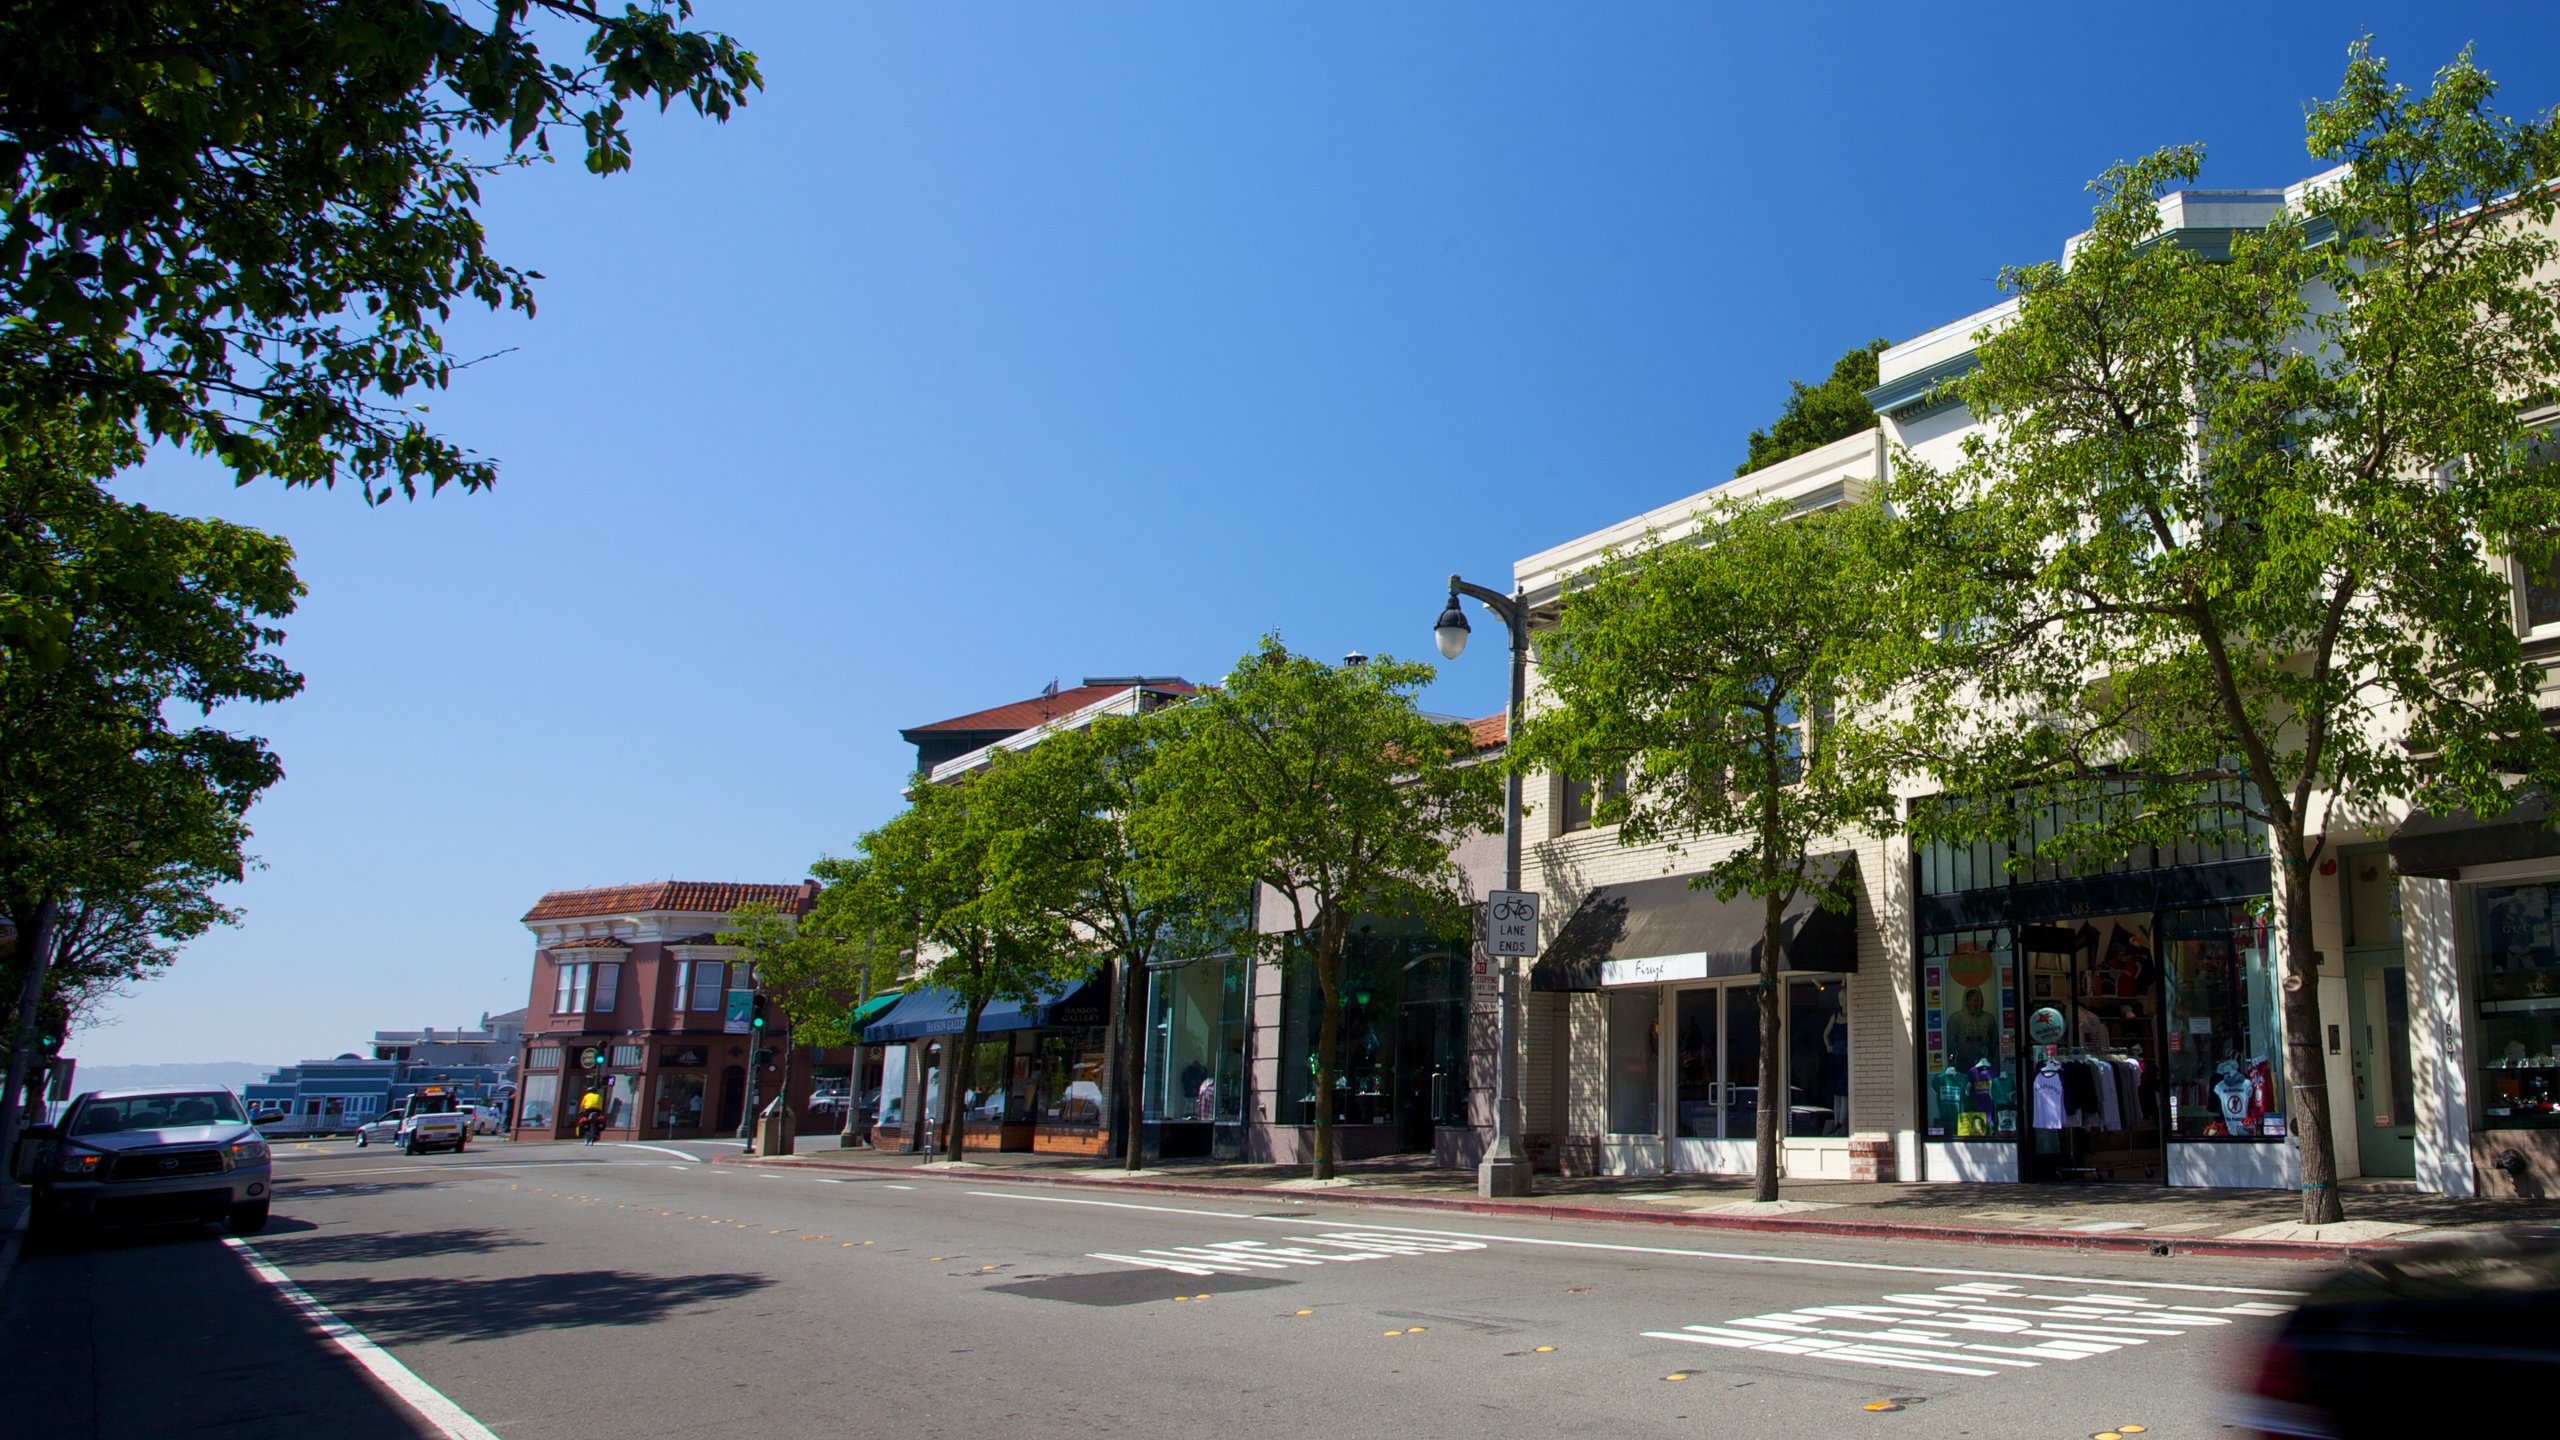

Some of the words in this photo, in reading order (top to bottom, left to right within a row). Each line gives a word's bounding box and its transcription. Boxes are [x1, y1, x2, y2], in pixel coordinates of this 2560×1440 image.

[2072, 901, 2090, 915] 683
[1500, 924, 1526, 936] LANE
[1499, 941, 1526, 952] ENDS
[1475, 963, 1486, 973] NO
[1476, 975, 1498, 984] STOPPING
[1064, 1007, 1098, 1015] HANSON
[1061, 1014, 1100, 1022] GALLERY
[926, 1021, 946, 1033] HANSON
[2445, 1023, 2454, 1063] 687
[1084, 1232, 1488, 1276] AHEAD
[1640, 1281, 2298, 1377] MERGE
